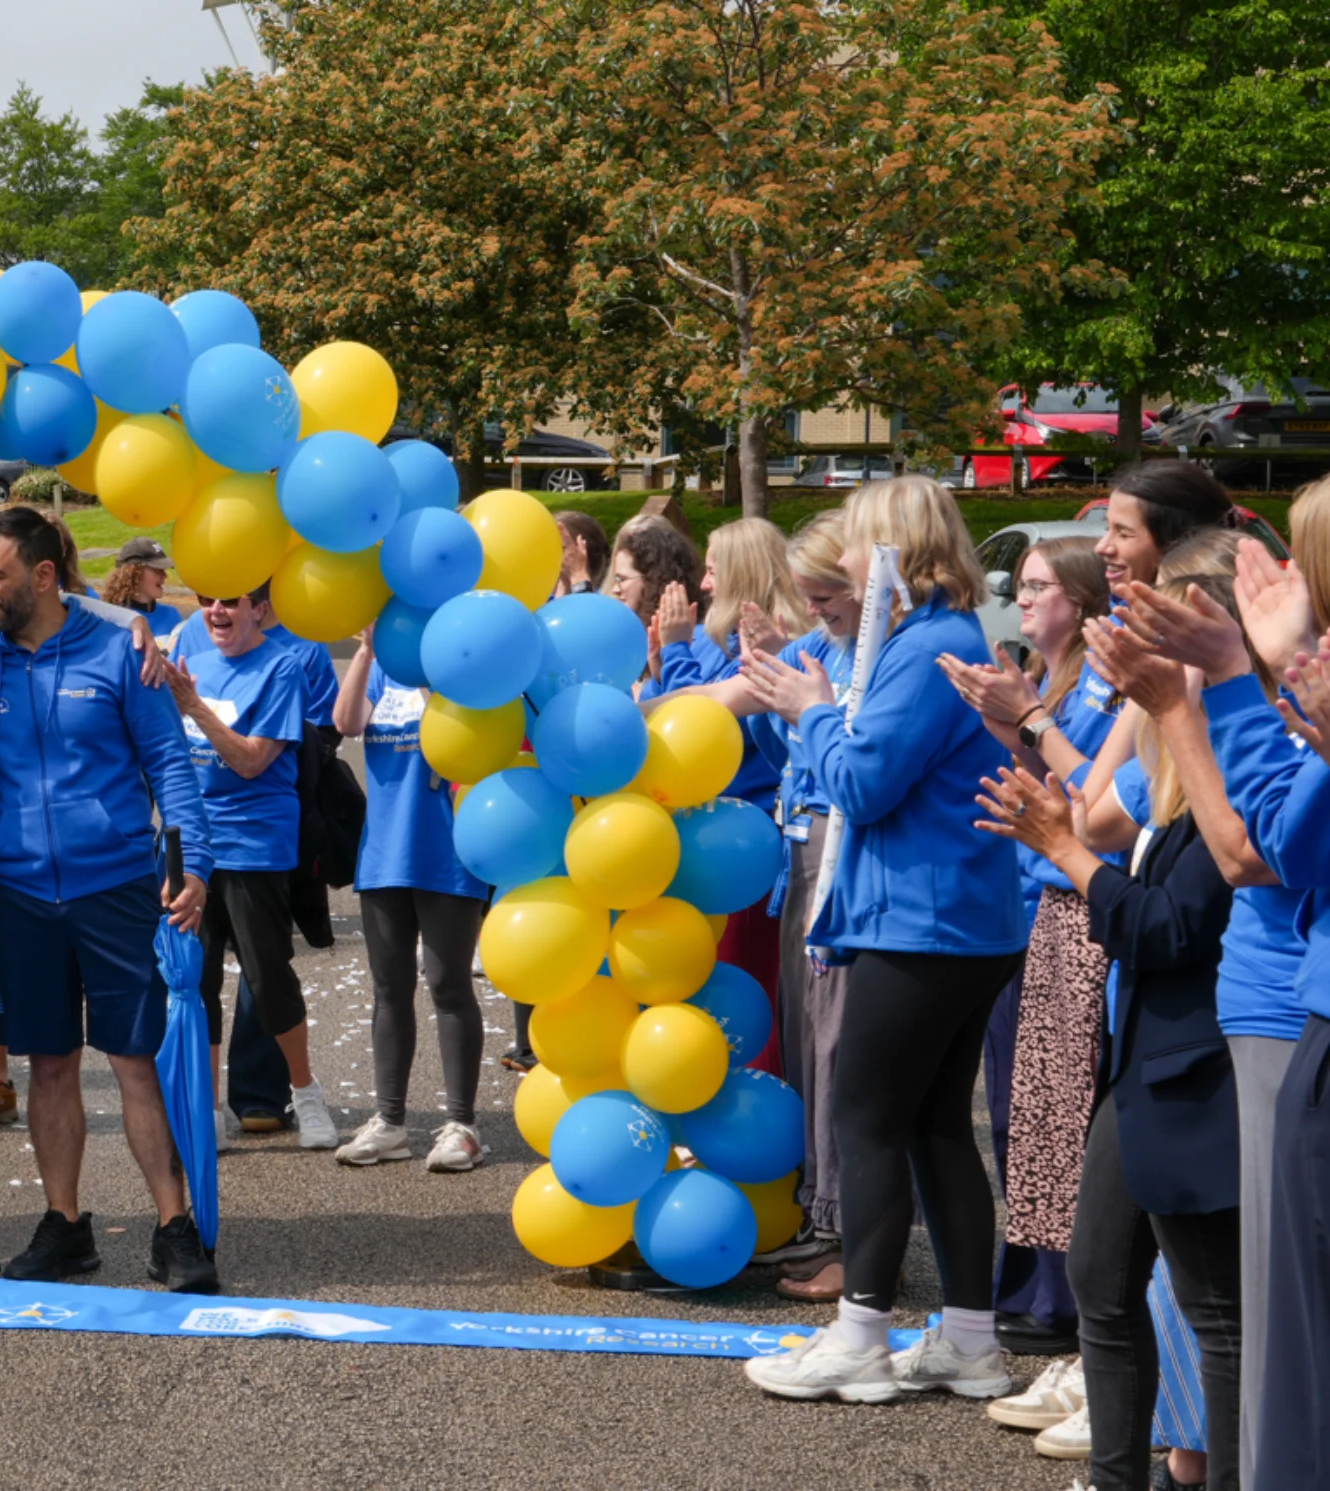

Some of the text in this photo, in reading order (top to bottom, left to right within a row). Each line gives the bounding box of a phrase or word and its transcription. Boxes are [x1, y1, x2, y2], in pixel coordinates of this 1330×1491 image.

[449, 1321, 735, 1343] Yorkshire Cancer
[586, 1334, 730, 1351] Research
